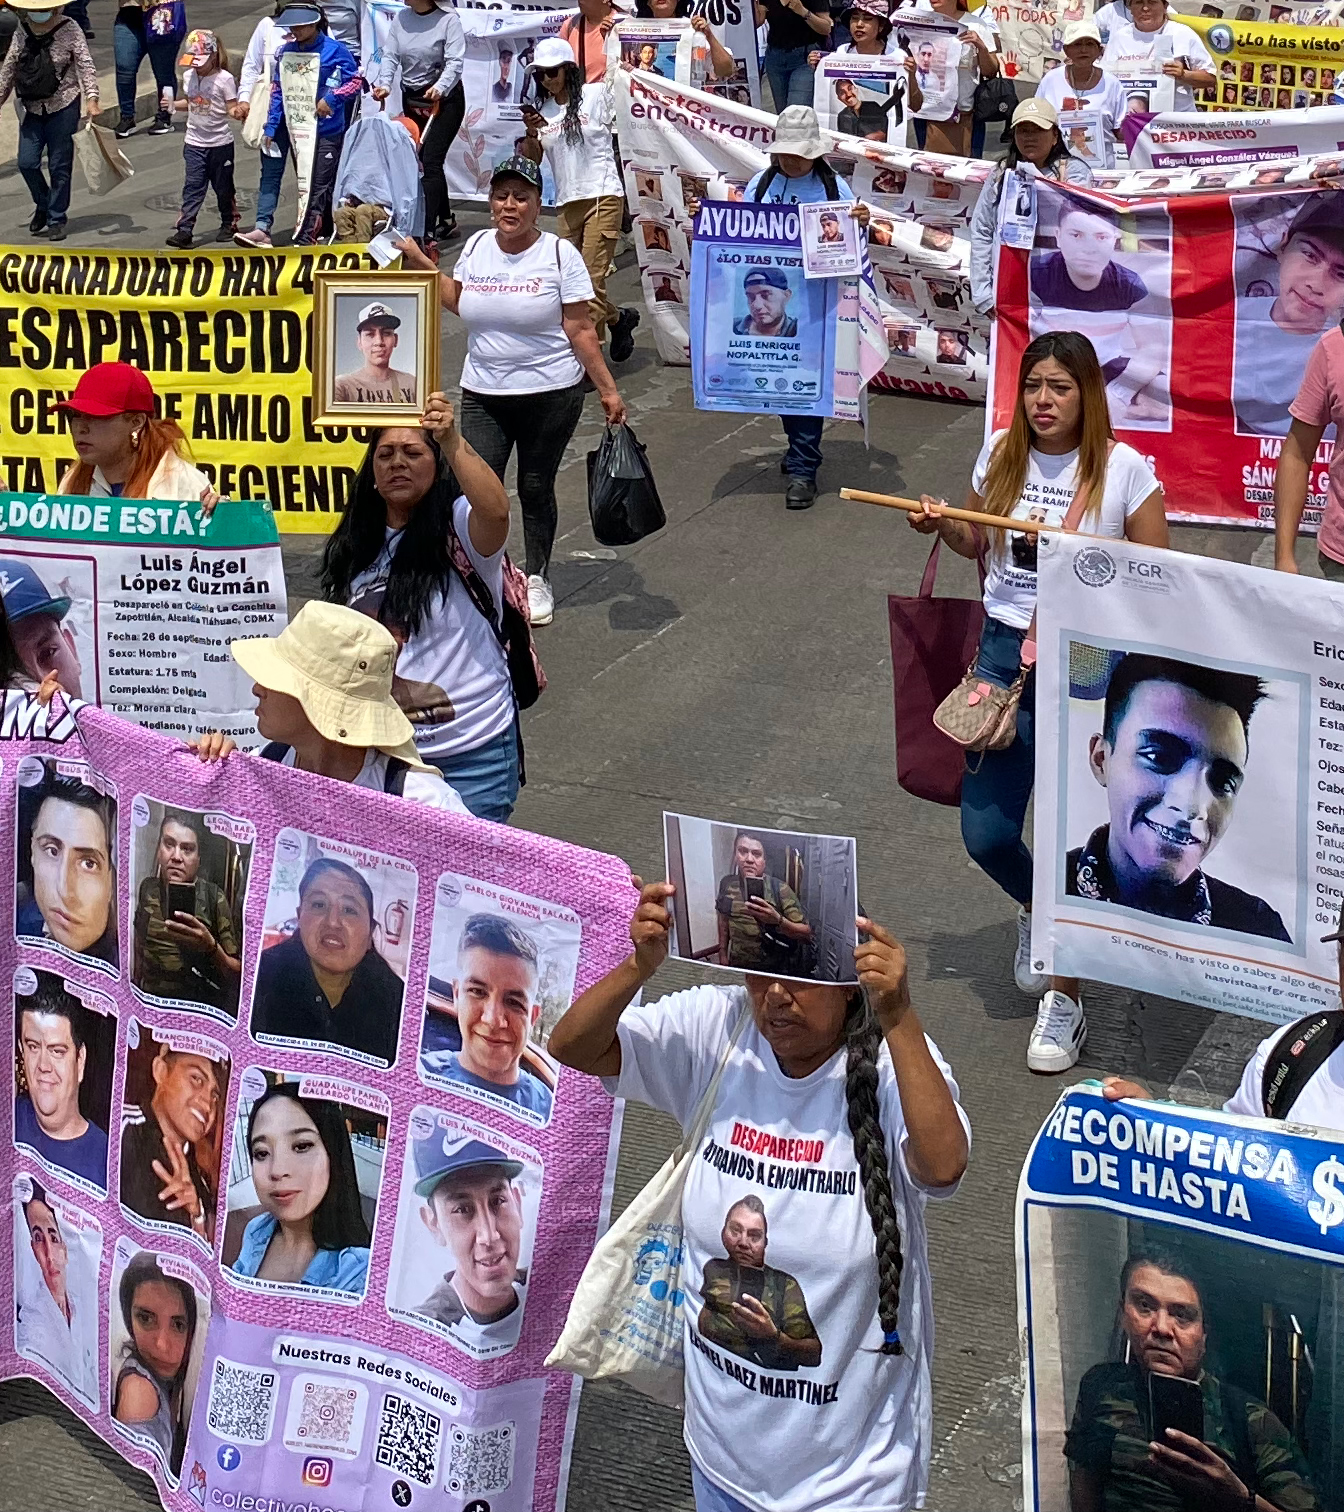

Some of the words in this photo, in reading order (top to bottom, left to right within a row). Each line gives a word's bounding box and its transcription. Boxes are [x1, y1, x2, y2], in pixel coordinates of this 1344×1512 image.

[1017, 7, 1057, 26] TODAS
[1237, 33, 1264, 47] ¿Lo
[1271, 35, 1296, 49] has
[1151, 129, 1256, 144] DESAPARECIDO
[1158, 155, 1185, 168] Miguel
[1189, 153, 1214, 166] Ángel
[1216, 151, 1256, 163] González
[1258, 148, 1297, 162] Vázquez
[698, 207, 801, 241] AYUDANO
[744, 255, 772, 266] HAS
[220, 255, 287, 296] HAY
[729, 339, 751, 349] LUIS
[754, 341, 801, 351] ENRIQUE
[192, 395, 290, 442] AMLO
[120, 502, 212, 537] ESTÁ?
[140, 555, 183, 572] Luis
[190, 551, 247, 578] Ángel
[1128, 560, 1162, 579] FGR
[120, 572, 181, 595] López
[188, 577, 270, 596] Guzmán
[244, 614, 275, 624] CDMX
[1318, 738, 1343, 754] Tez:
[1125, 939, 1173, 960] conoces,
[1175, 951, 1196, 965] has
[1199, 955, 1230, 972] visto
[1242, 966, 1277, 981] sabes
[1280, 973, 1305, 989] algo
[1046, 1103, 1300, 1185] RECOMPENSA
[756, 1164, 765, 1185] A
[1072, 1150, 1120, 1190] DE
[1130, 1159, 1252, 1223] HASTA
[279, 1341, 351, 1367] Nuestras
[357, 1357, 402, 1381] Redes
[405, 1370, 458, 1407] Sociales
[759, 1375, 839, 1406] MARTINEZ
